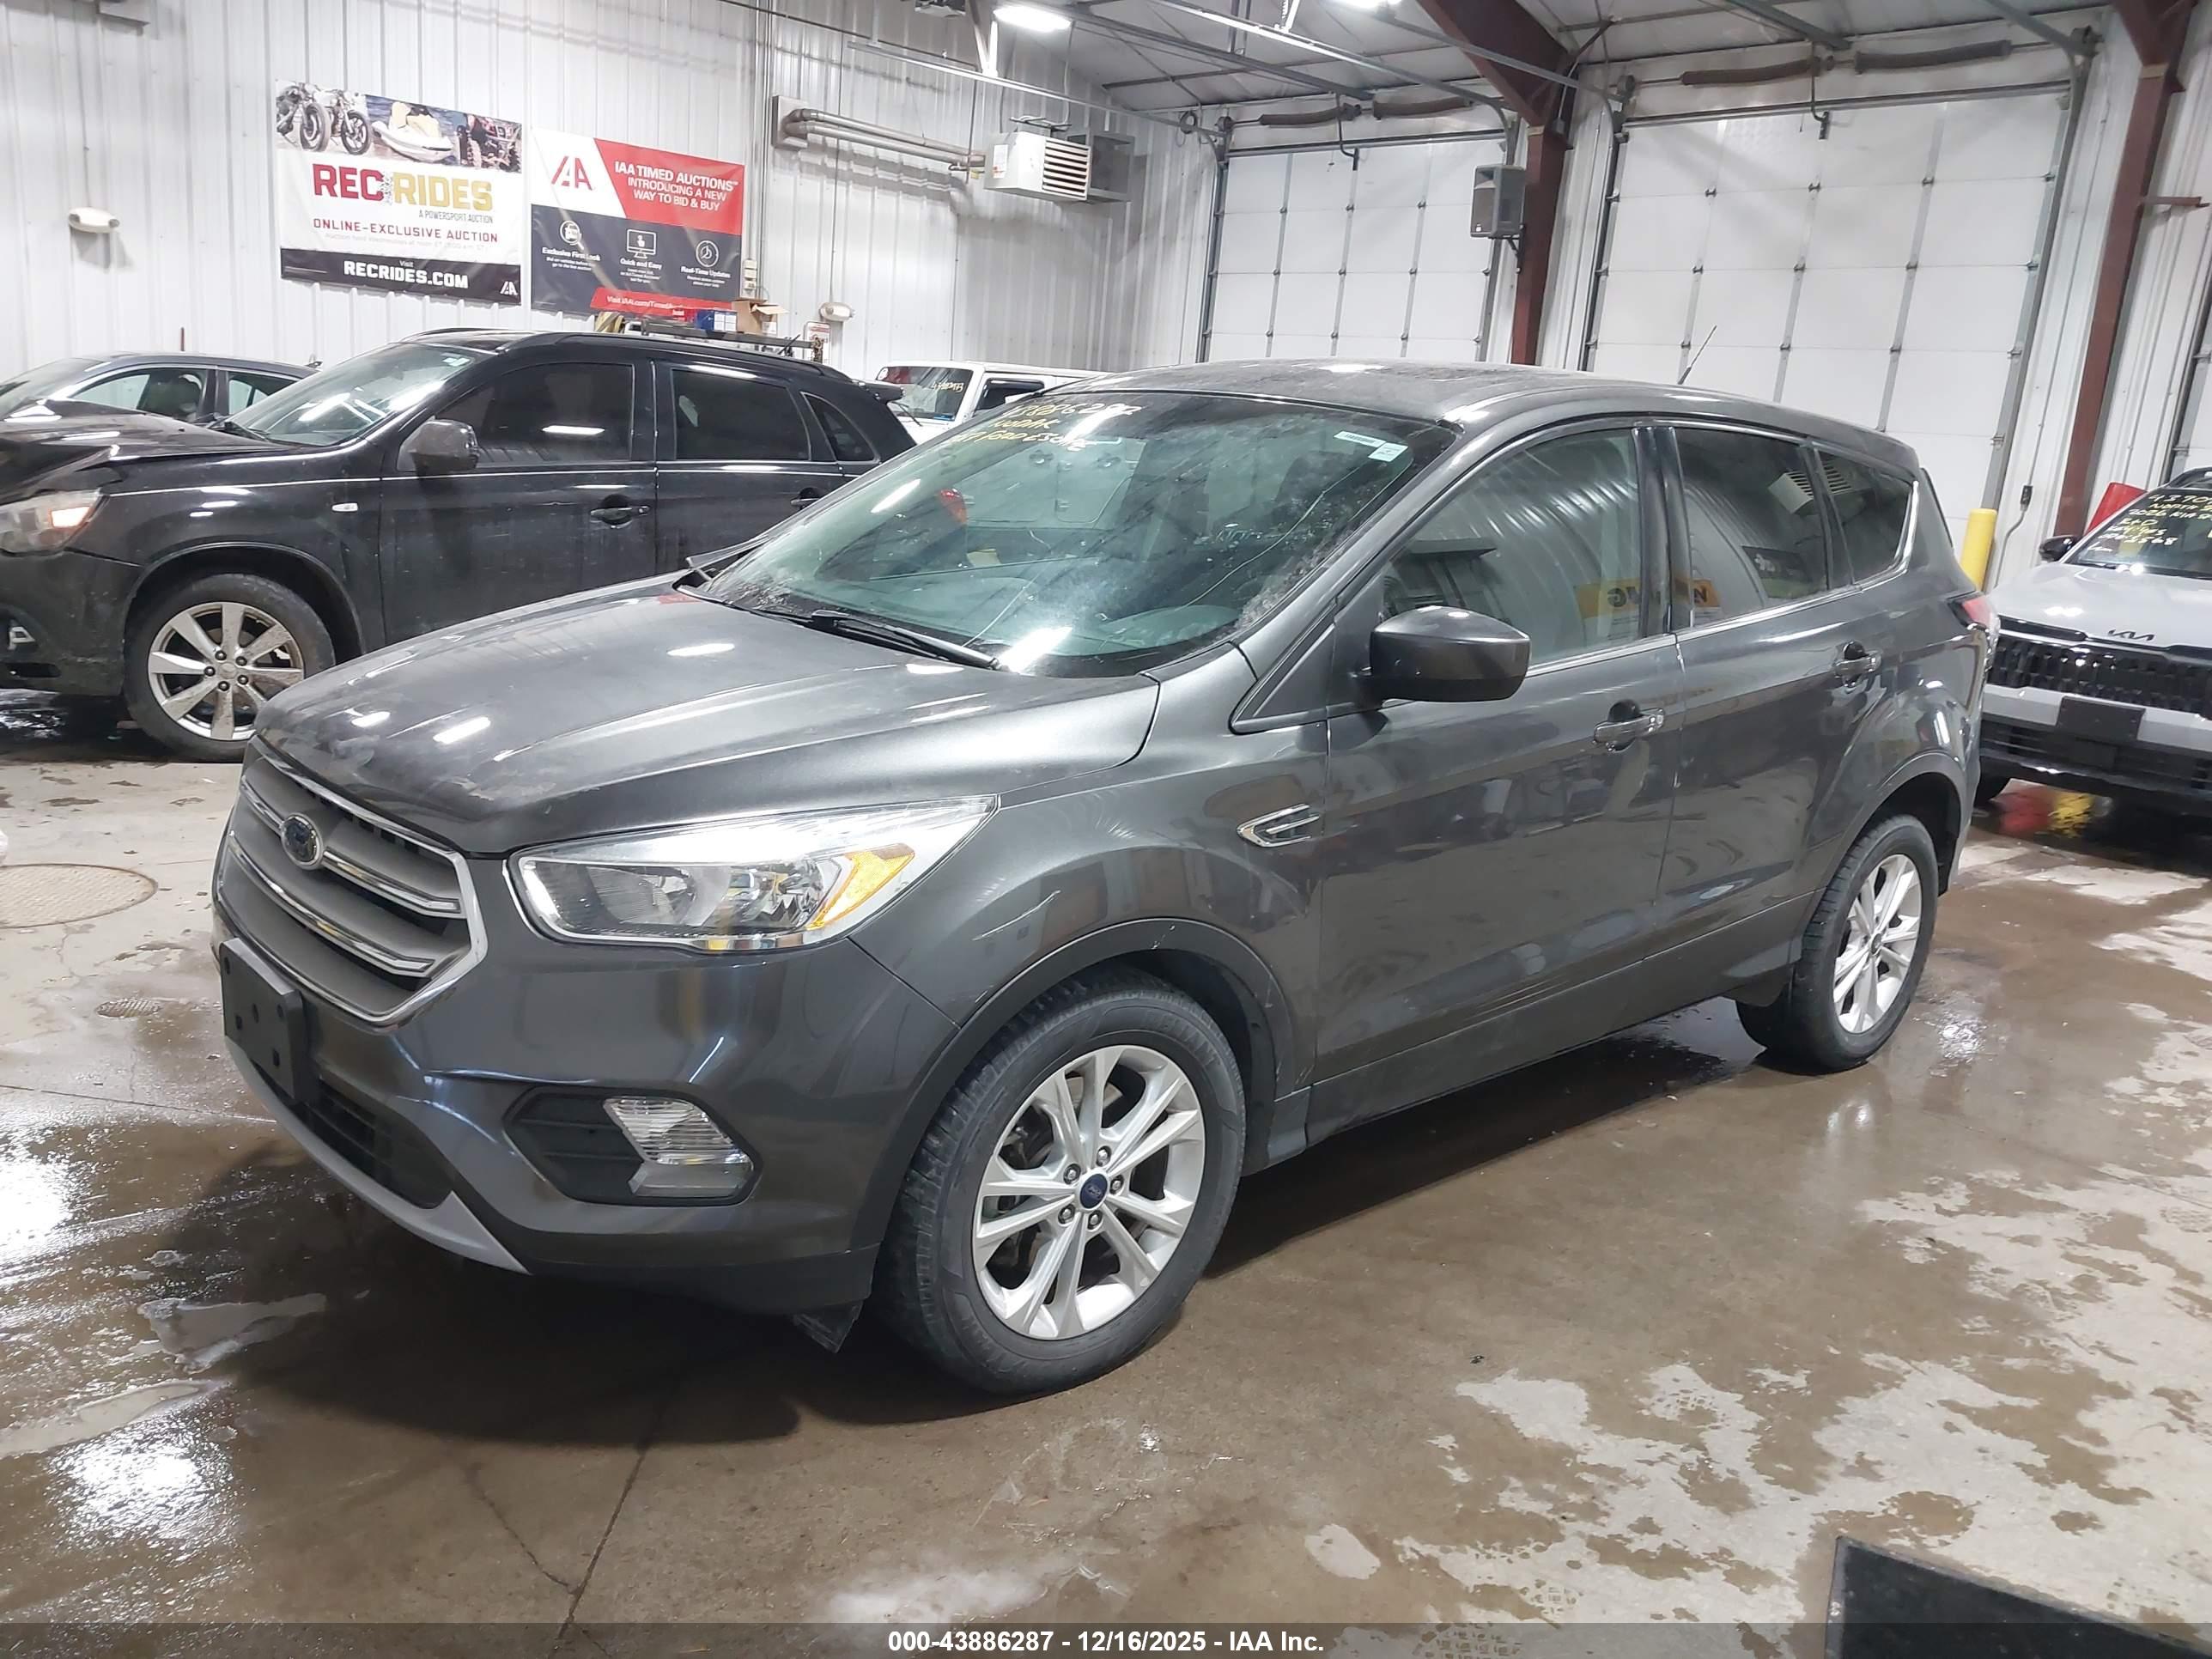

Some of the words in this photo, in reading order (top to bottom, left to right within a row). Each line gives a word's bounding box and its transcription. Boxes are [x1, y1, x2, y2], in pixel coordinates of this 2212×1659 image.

[615, 161, 635, 175] IAA
[636, 164, 674, 181] TIMED
[313, 163, 385, 202] REC
[392, 172, 493, 212] RIDES
[628, 177, 693, 197] INTRODUCING
[694, 187, 702, 198] A
[704, 189, 727, 202] NEW
[633, 188, 657, 201] WAY
[658, 191, 672, 204] TO
[673, 194, 689, 207] BID
[690, 198, 698, 209] &
[700, 198, 721, 212] BUY
[424, 210, 467, 223] POWERSPORT
[467, 214, 494, 225] AUCTION
[313, 217, 441, 239] ONLINE-EXCLUSIVE
[447, 229, 499, 243] AUCTION
[343, 260, 469, 289] RECRIDES.COM
[620, 258, 635, 266] Quick
[636, 259, 647, 268] and
[647, 262, 662, 270] Easy
